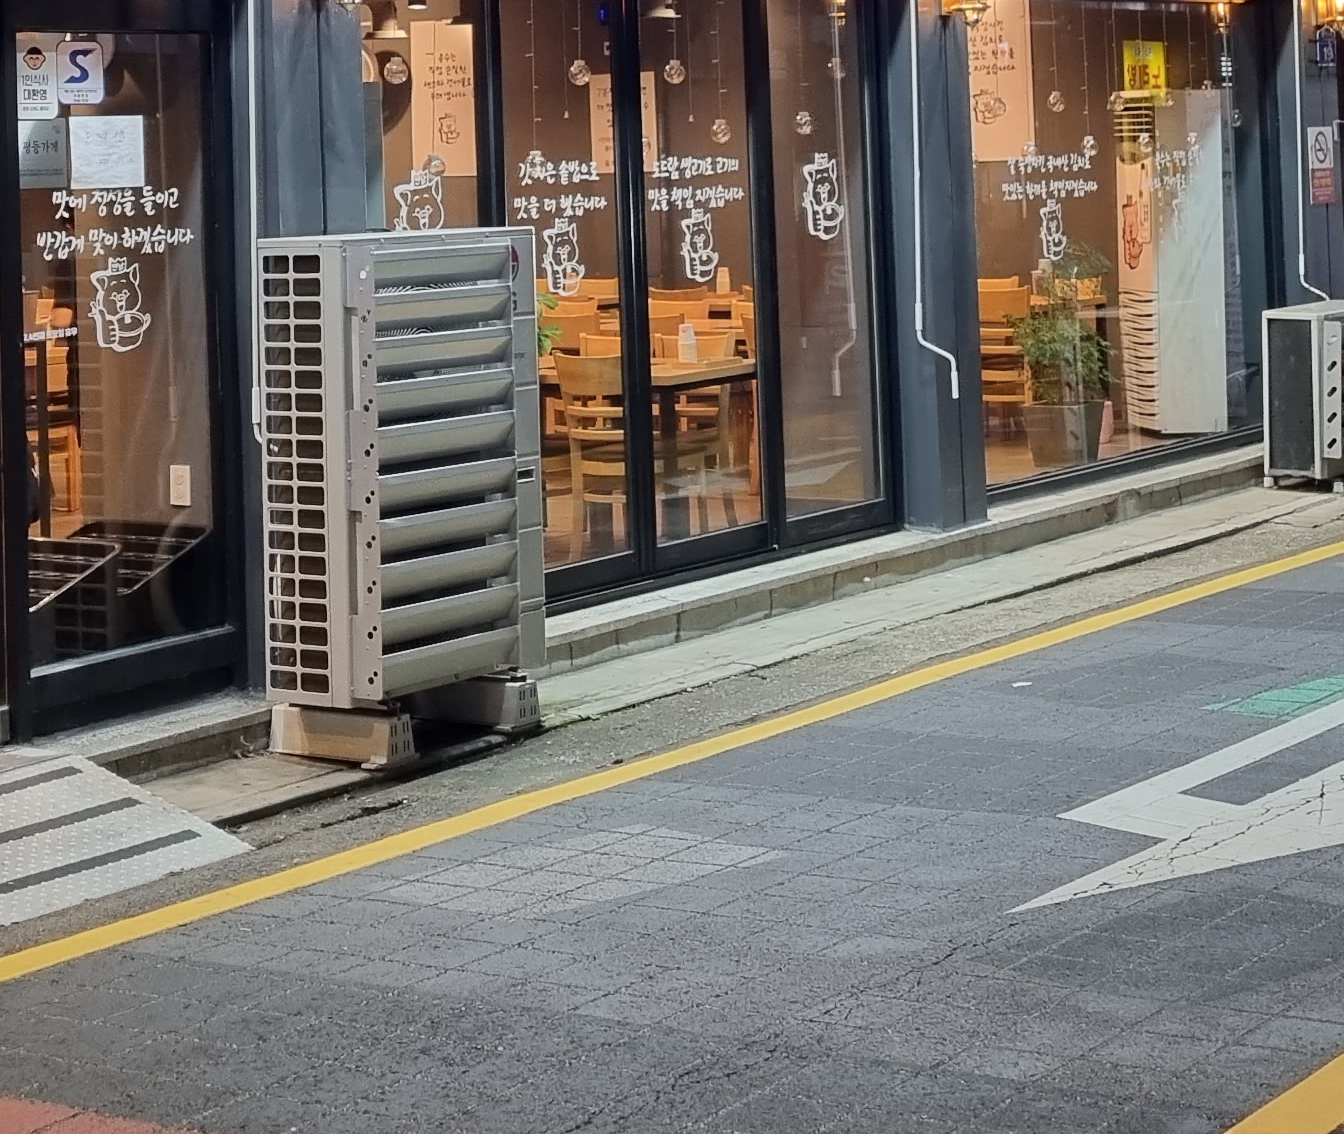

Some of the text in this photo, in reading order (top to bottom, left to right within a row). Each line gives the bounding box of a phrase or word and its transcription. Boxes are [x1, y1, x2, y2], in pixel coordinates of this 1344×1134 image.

[20, 74, 49, 87] 1인식사
[23, 89, 47, 101] 대환영
[23, 140, 59, 155] 평등가게
[558, 159, 600, 185] 솥밥으로
[652, 156, 739, 180] 도드람 생고기로 고기의
[1070, 152, 1092, 172] 김치로
[52, 185, 180, 220] 맛에 정성을 들이고
[648, 184, 745, 211] 맛을 책임 지겠습니다
[1001, 182, 1025, 202] 맛있는
[513, 192, 608, 220] 맛을 더 했습니다
[36, 223, 195, 262] 반갑게 맞이 하겠습니다
